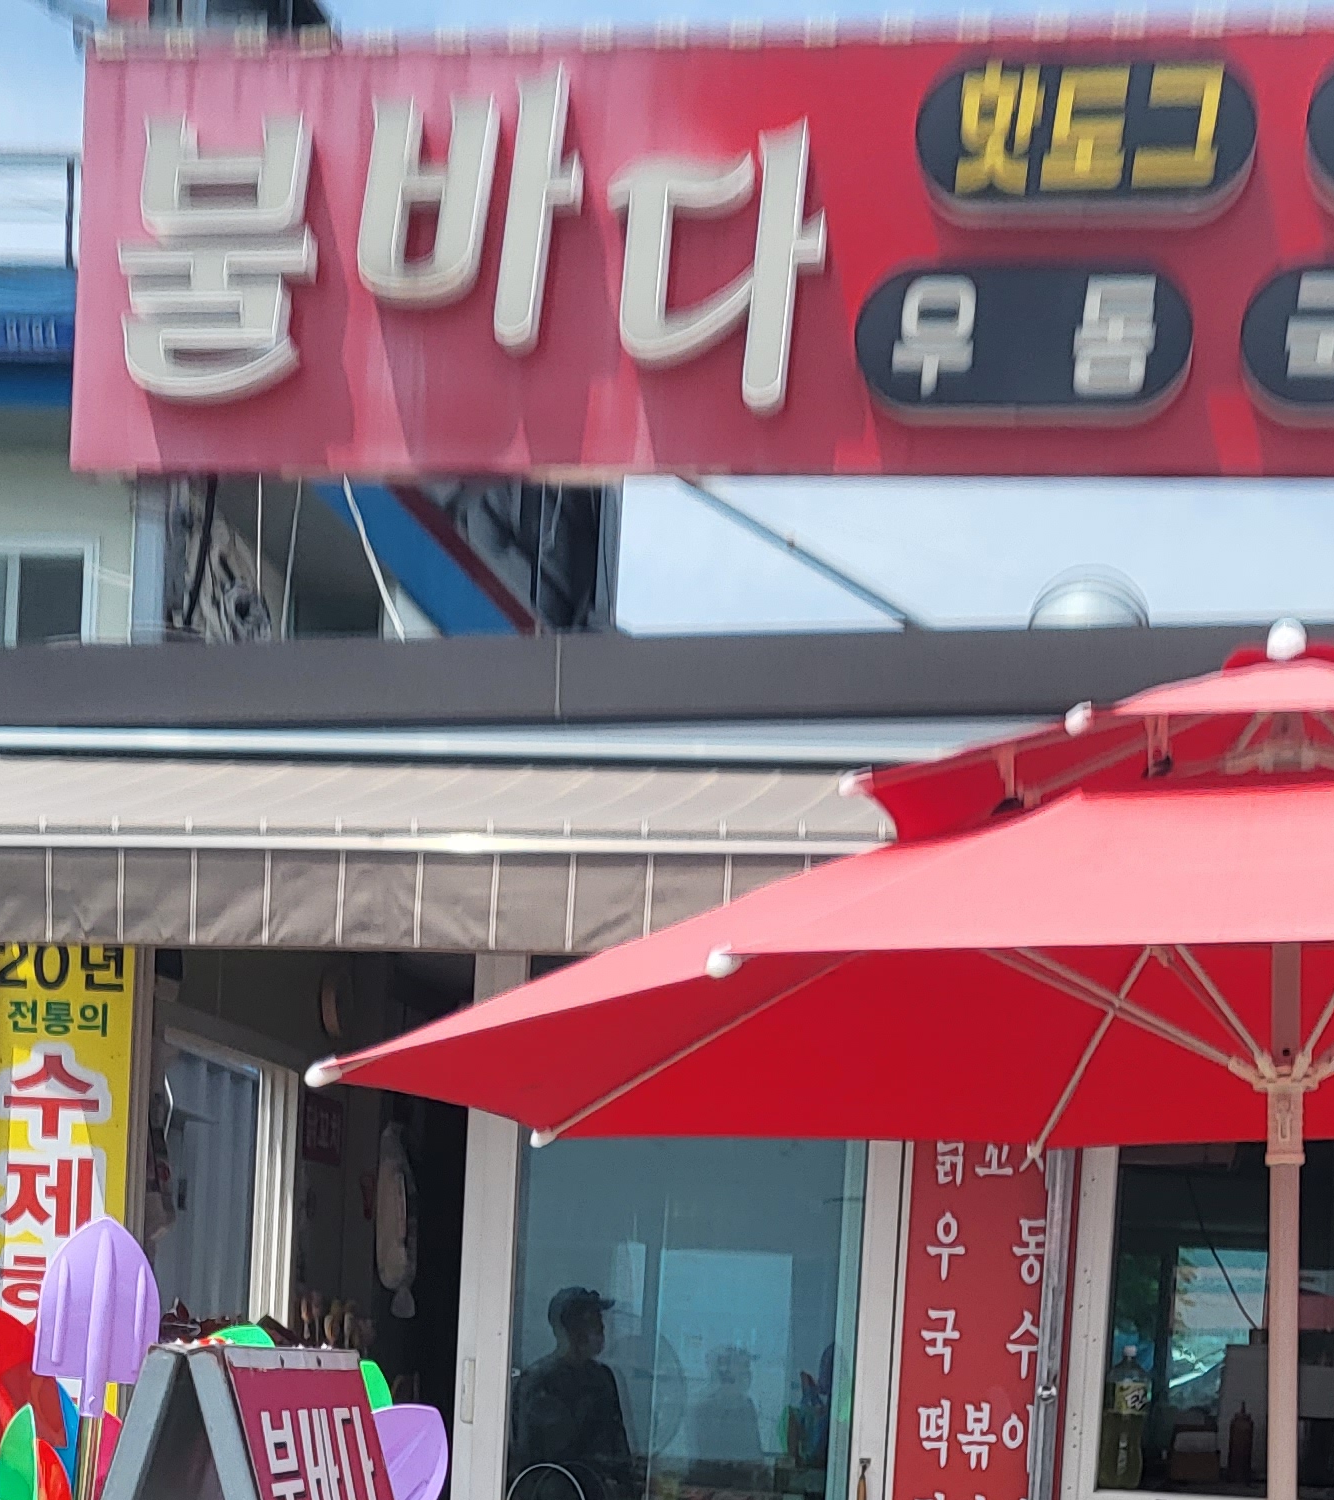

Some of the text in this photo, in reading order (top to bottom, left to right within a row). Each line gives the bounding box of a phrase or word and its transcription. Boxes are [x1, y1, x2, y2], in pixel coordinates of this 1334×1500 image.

[956, 62, 1225, 197] 핫도그
[118, 62, 827, 416] 불바다
[8, 1000, 108, 1037] 전통의
[917, 1398, 1032, 1473] 떡볶이
